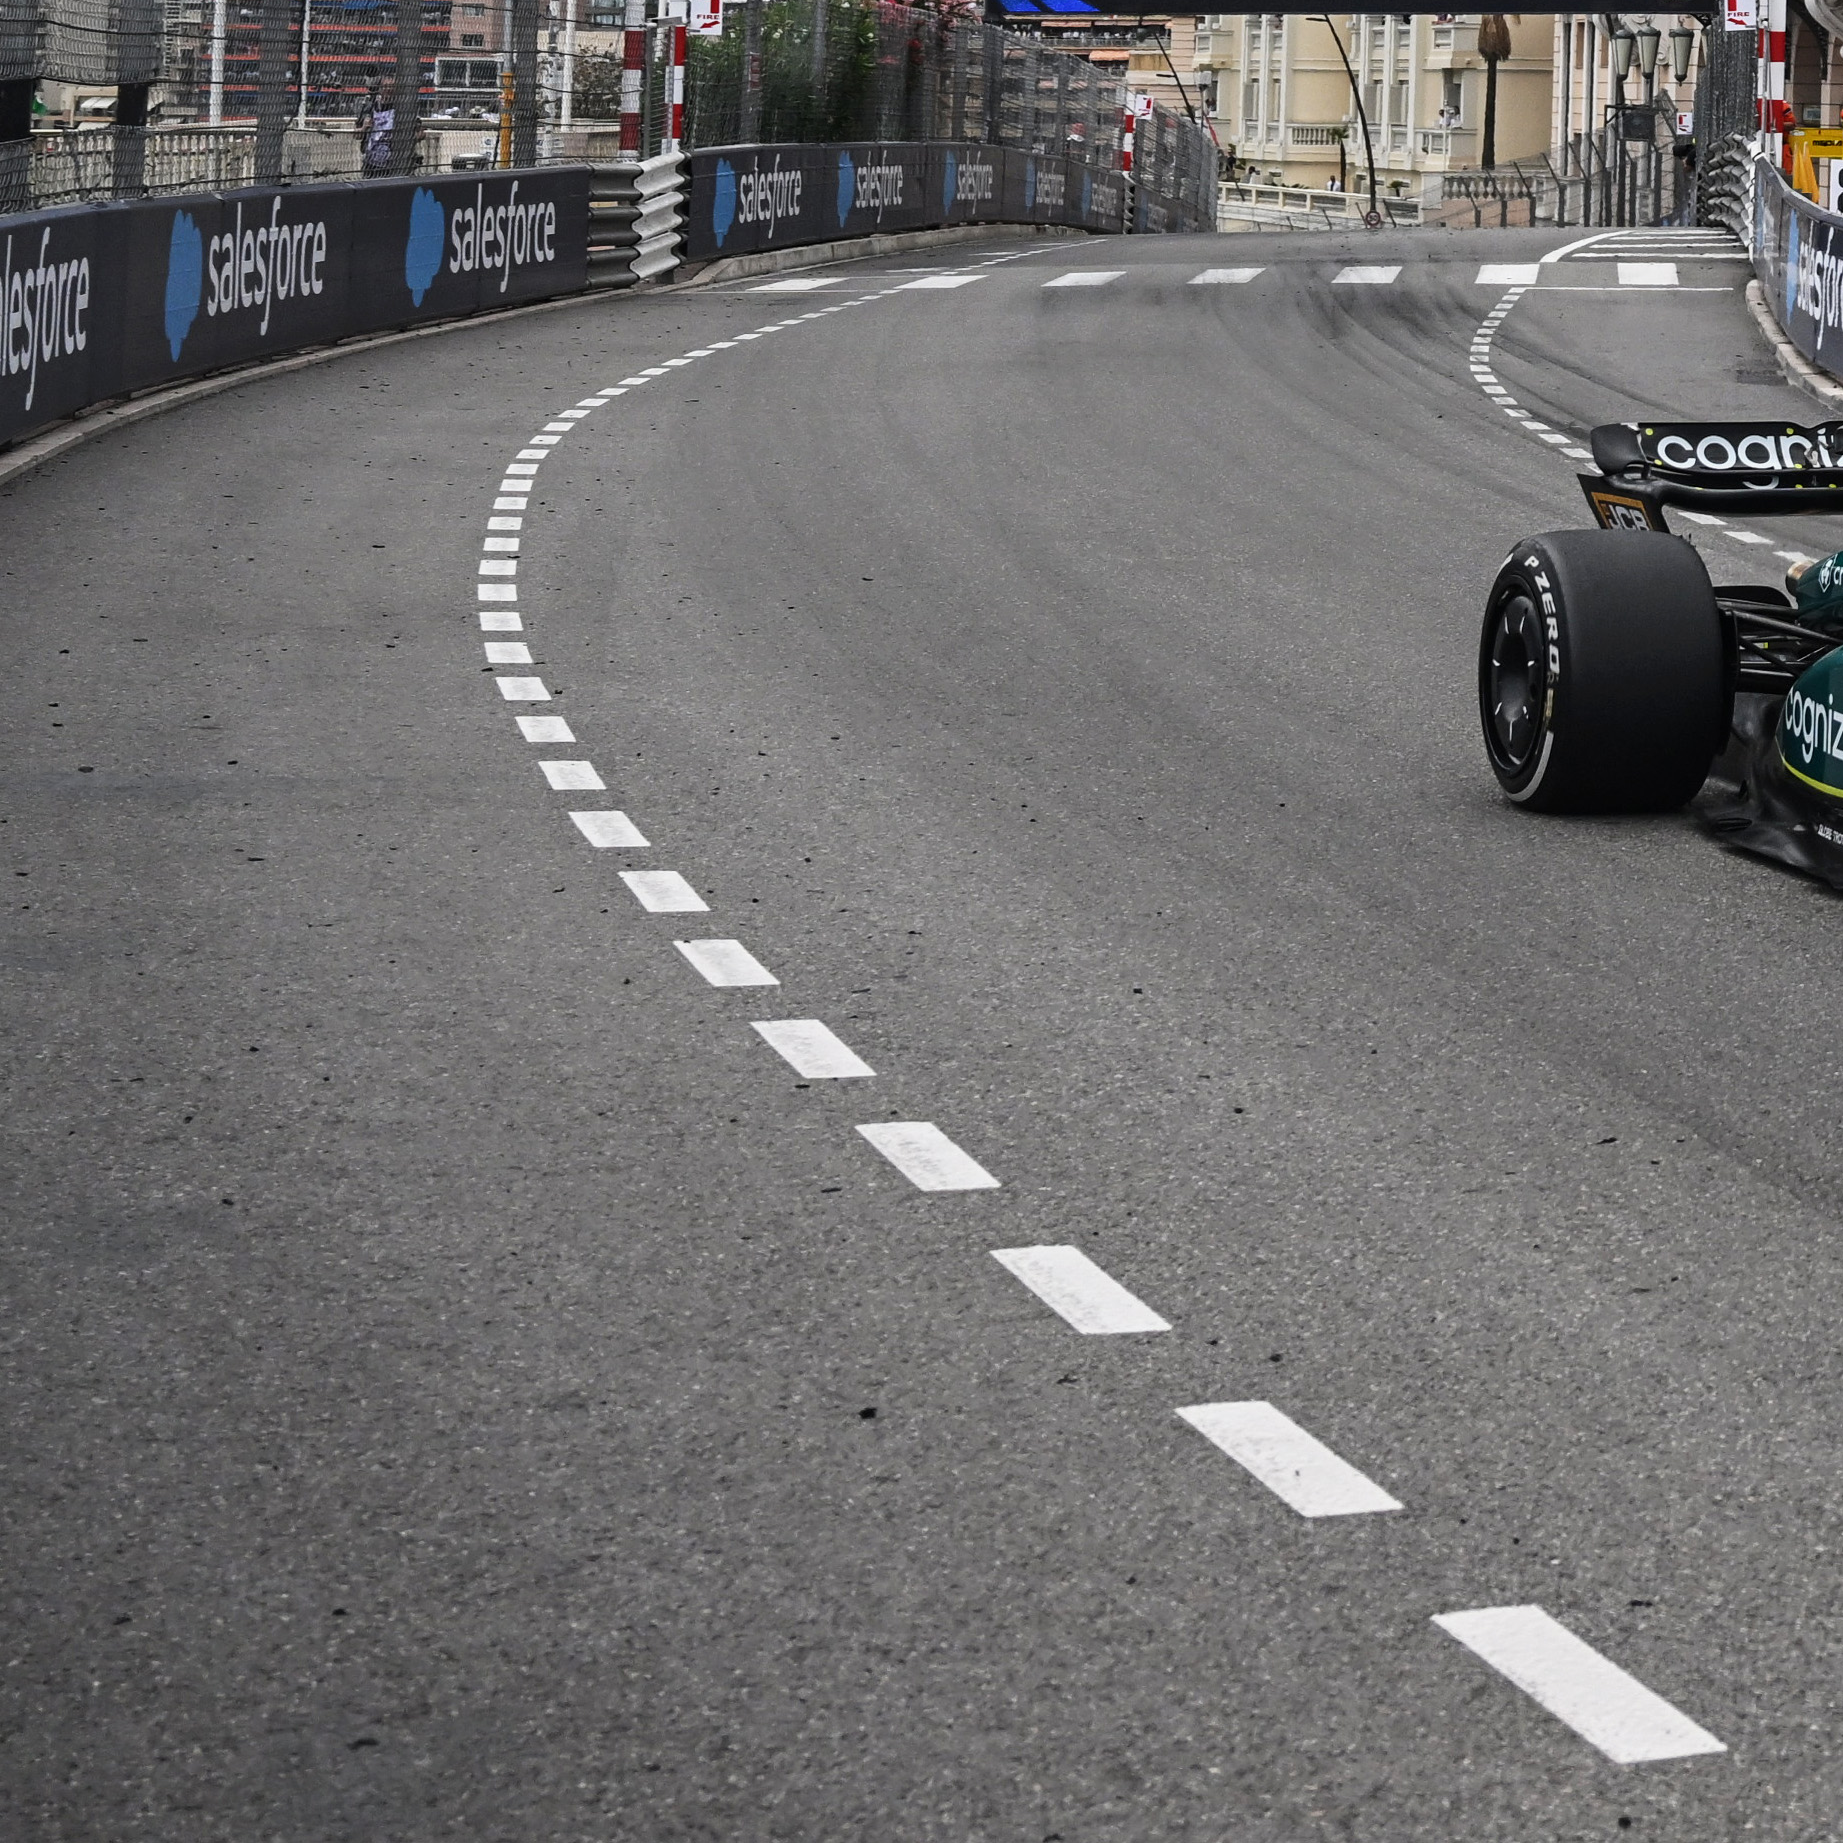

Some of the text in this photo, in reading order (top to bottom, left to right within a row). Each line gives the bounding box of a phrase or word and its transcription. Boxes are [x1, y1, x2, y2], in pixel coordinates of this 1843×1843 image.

[737, 147, 802, 239] salesforce
[855, 151, 904, 228] salesforce
[957, 149, 993, 218] salesforce
[207, 195, 326, 336] salesforce
[449, 181, 556, 293] salesforce
[0, 226, 89, 411] lesforce
[1608, 505, 1650, 530] JCB
[1534, 571, 1561, 675] ZERO
